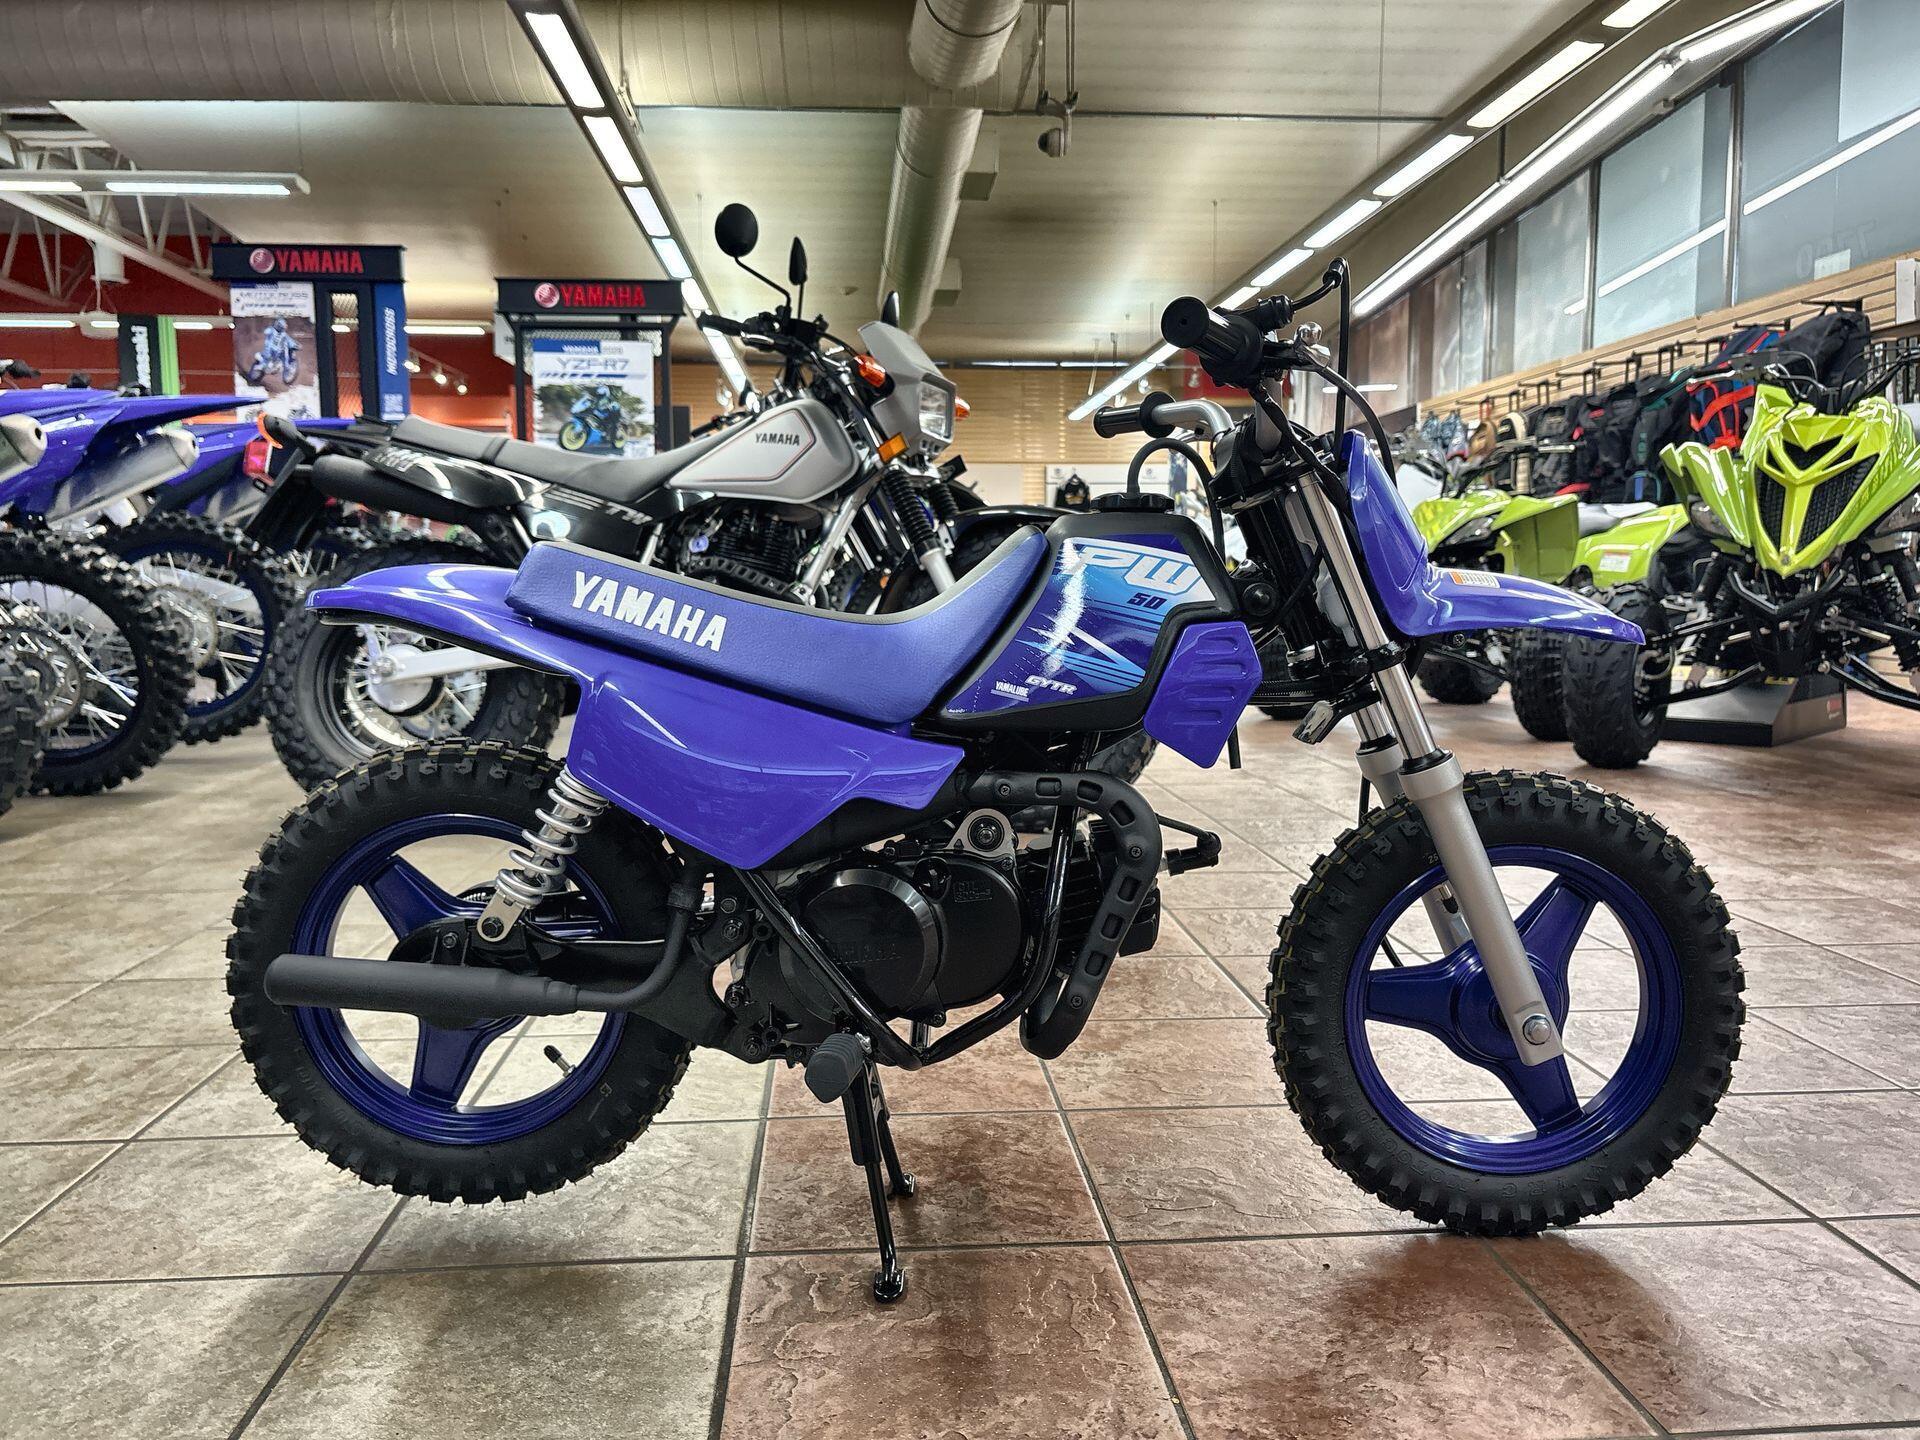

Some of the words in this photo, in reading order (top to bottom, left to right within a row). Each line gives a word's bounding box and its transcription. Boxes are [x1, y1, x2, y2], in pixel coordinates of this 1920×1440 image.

[273, 250, 364, 274] YAMAHA
[559, 284, 647, 308] YAMAHA
[557, 357, 630, 371] YZF-R7
[755, 432, 801, 446] YAMAHA
[1064, 544, 1203, 596] PW
[571, 570, 728, 652] YAMAHA
[1127, 592, 1168, 611] 50
[995, 680, 1030, 697] YAMALUBE
[1024, 674, 1078, 695] GYTR
